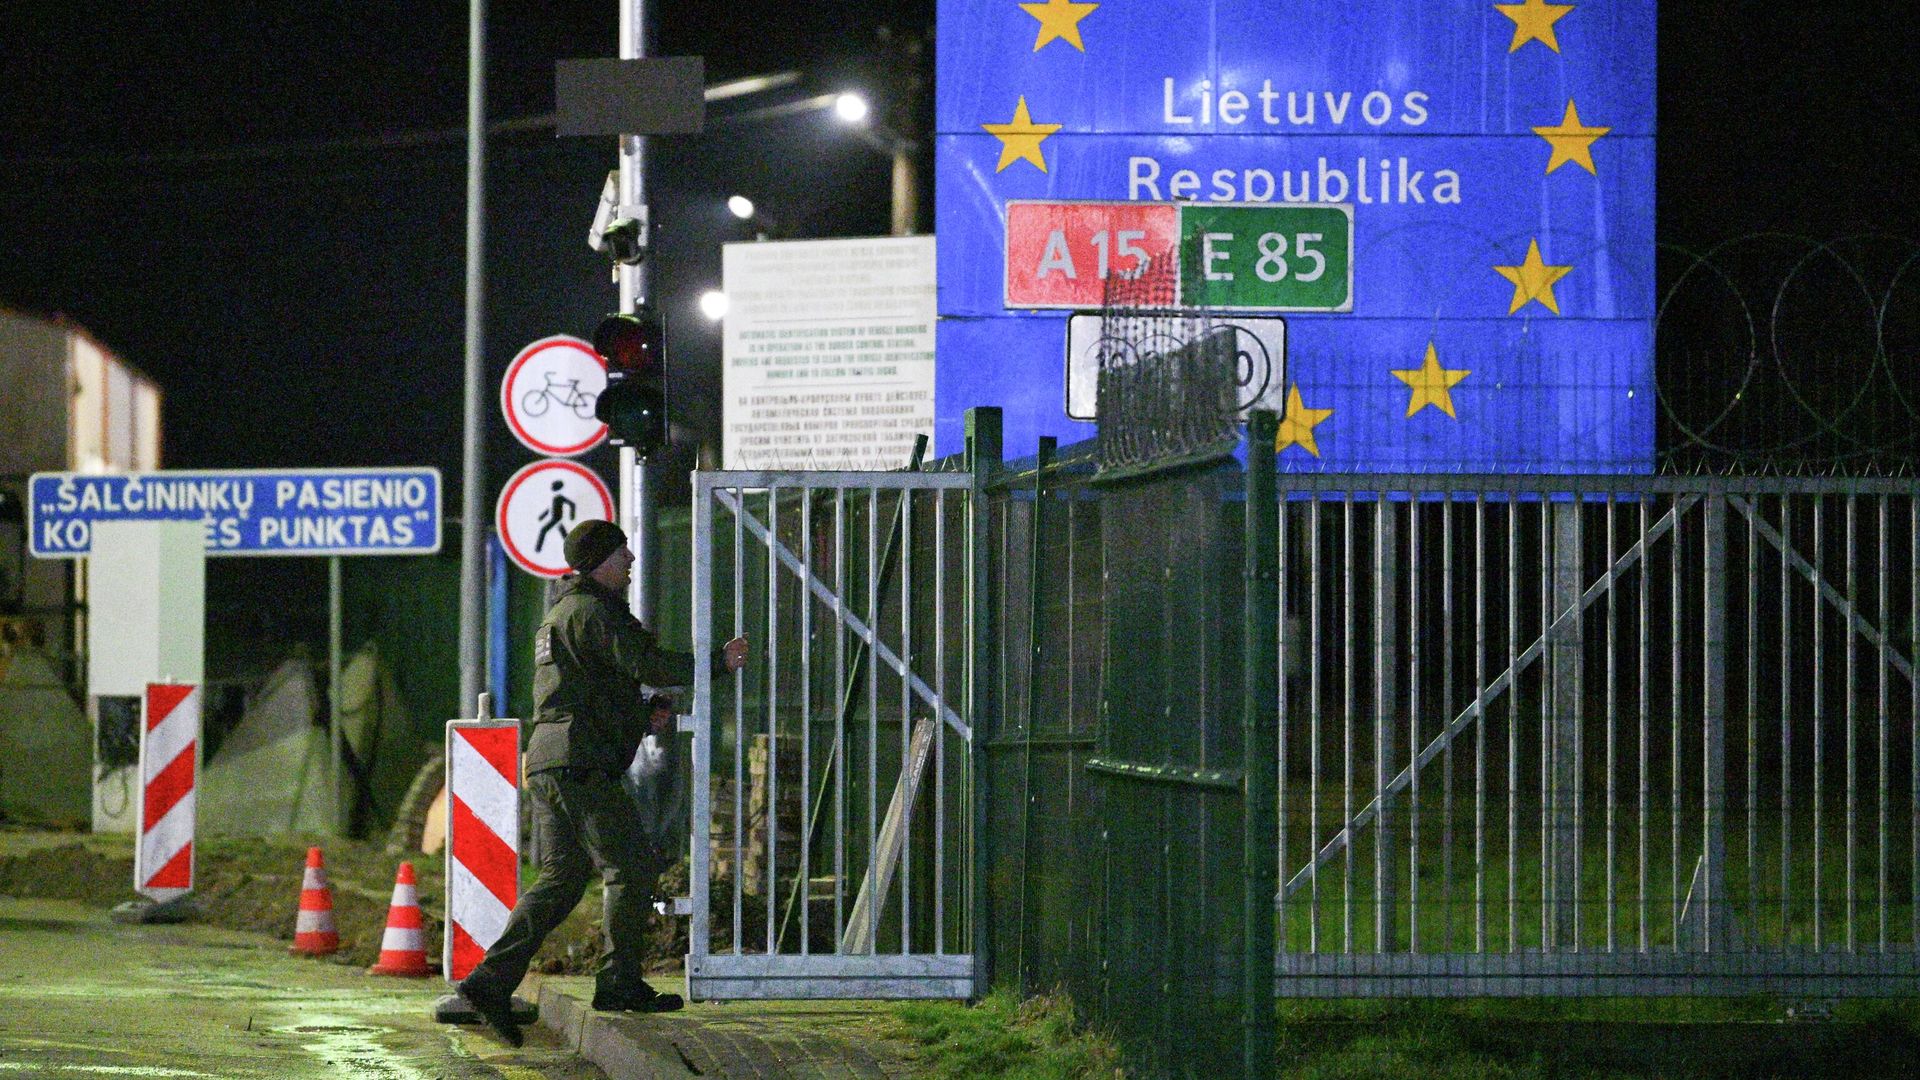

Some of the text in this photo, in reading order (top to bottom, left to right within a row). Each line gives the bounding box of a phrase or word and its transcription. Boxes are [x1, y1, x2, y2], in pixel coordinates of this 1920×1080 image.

[1163, 77, 1430, 126] Lietuvos
[1128, 156, 1462, 204] Respublika
[1036, 230, 1151, 281] A 15
[1203, 231, 1327, 283] E 85
[276, 477, 427, 510] PASIENIO
